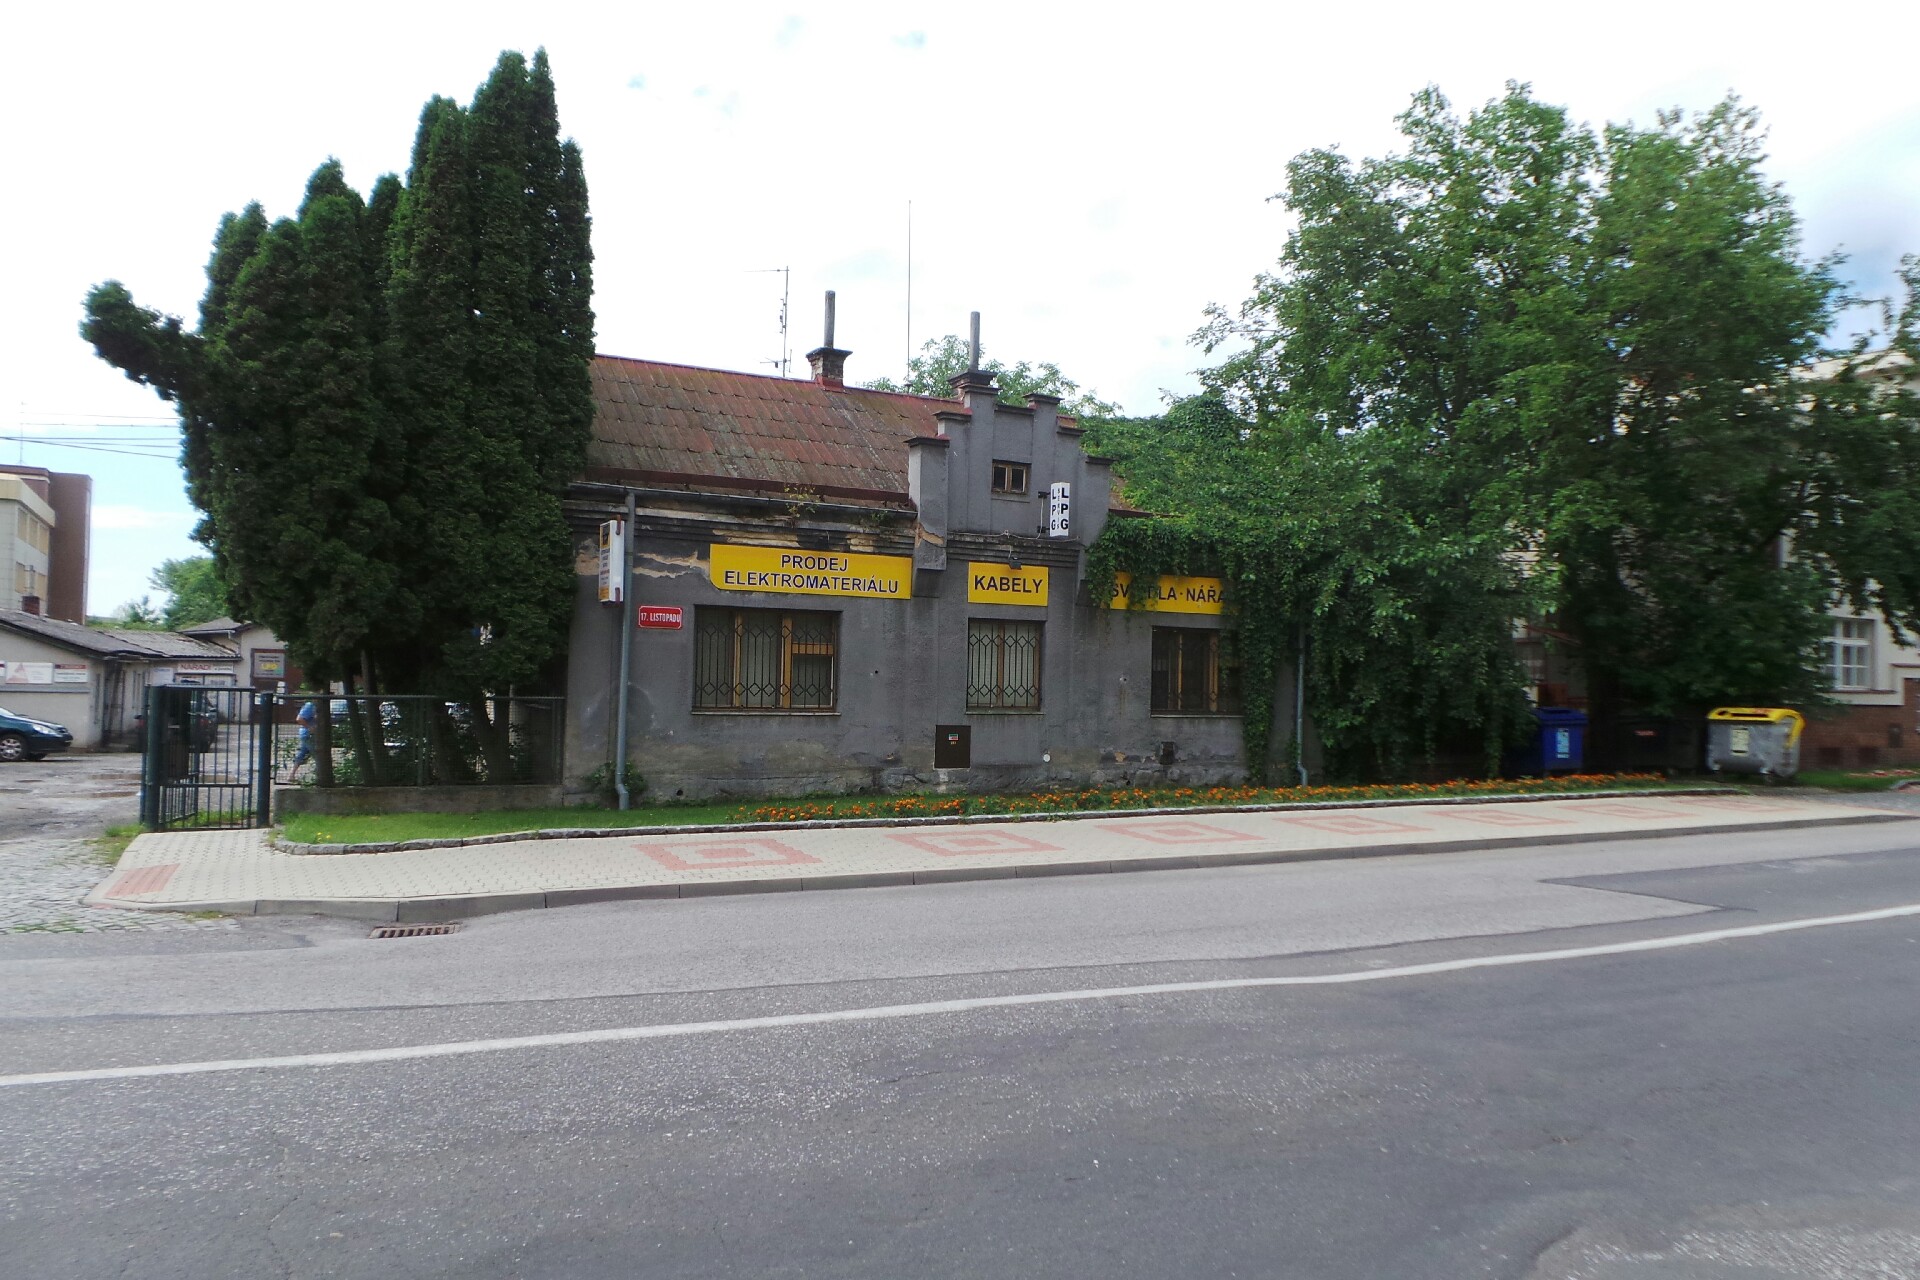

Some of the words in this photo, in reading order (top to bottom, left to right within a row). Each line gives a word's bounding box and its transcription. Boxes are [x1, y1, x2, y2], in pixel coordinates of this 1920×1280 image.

[1061, 487, 1069, 529] LPG
[781, 554, 848, 571] PRODEJ
[724, 570, 898, 593] ELEKTROMATERIÁLU
[974, 575, 1043, 593] KABELY
[640, 612, 649, 621] 17.
[650, 612, 681, 622] LISTOPADU
